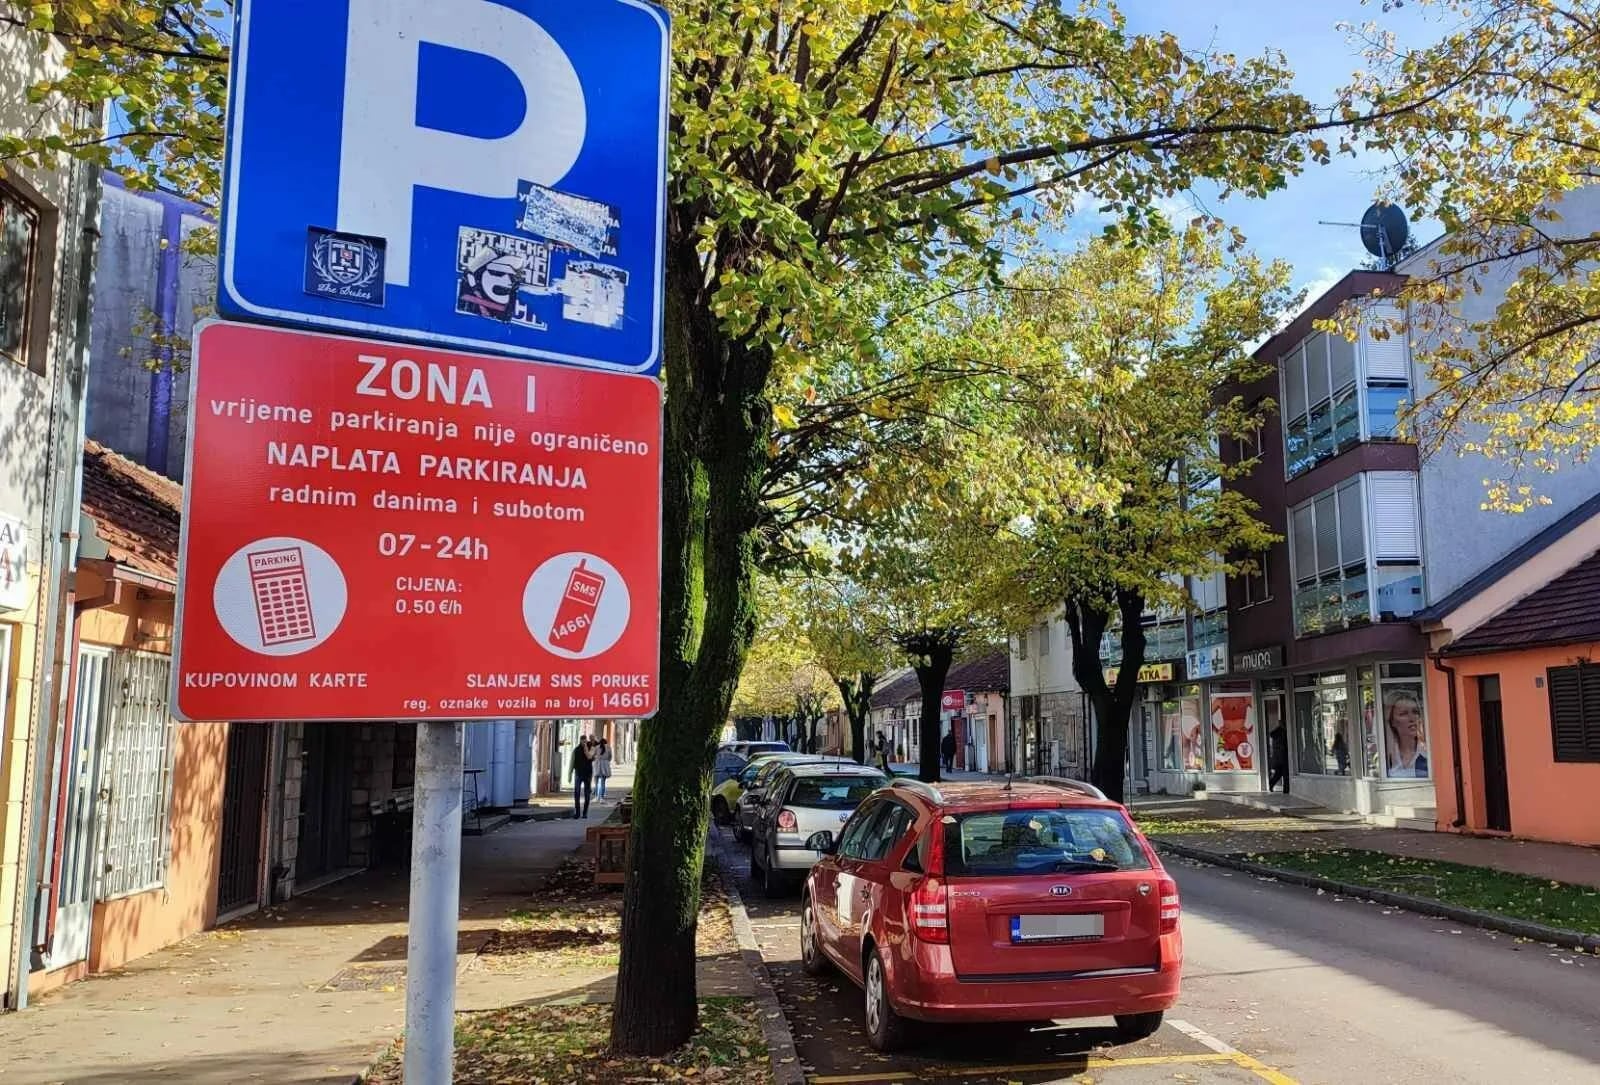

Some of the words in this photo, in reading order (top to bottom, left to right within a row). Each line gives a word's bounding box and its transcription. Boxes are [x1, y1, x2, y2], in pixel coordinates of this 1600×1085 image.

[336, 0, 587, 287] P
[356, 354, 493, 409] ZONA
[526, 374, 537, 413] I
[210, 397, 313, 424] vrijeme
[330, 410, 459, 439] parkiranja
[474, 424, 516, 446] nije
[530, 430, 649, 456] ograničeno
[267, 441, 401, 474] NAPLATA
[419, 454, 588, 489] PARKIRANJA
[270, 483, 356, 506] radnim
[373, 488, 457, 513] danima
[472, 495, 478, 514] i
[493, 500, 585, 522] subotom
[255, 553, 297, 567] PARKING
[396, 576, 463, 593] CIJENA:
[572, 580, 597, 597] SMS
[552, 613, 592, 640] 14661
[185, 672, 298, 688] KUPOVINOM
[309, 673, 368, 688] KARTE
[466, 673, 541, 688] SLANJEM
[550, 674, 583, 688] SMS
[591, 674, 649, 688] PORUKE
[403, 699, 431, 712] reg.
[439, 696, 489, 709] oznake
[497, 696, 537, 709] vozila
[545, 699, 561, 708] na
[568, 696, 594, 711] broj
[603, 692, 649, 708] 14661
[1051, 886, 1069, 895] KIA
